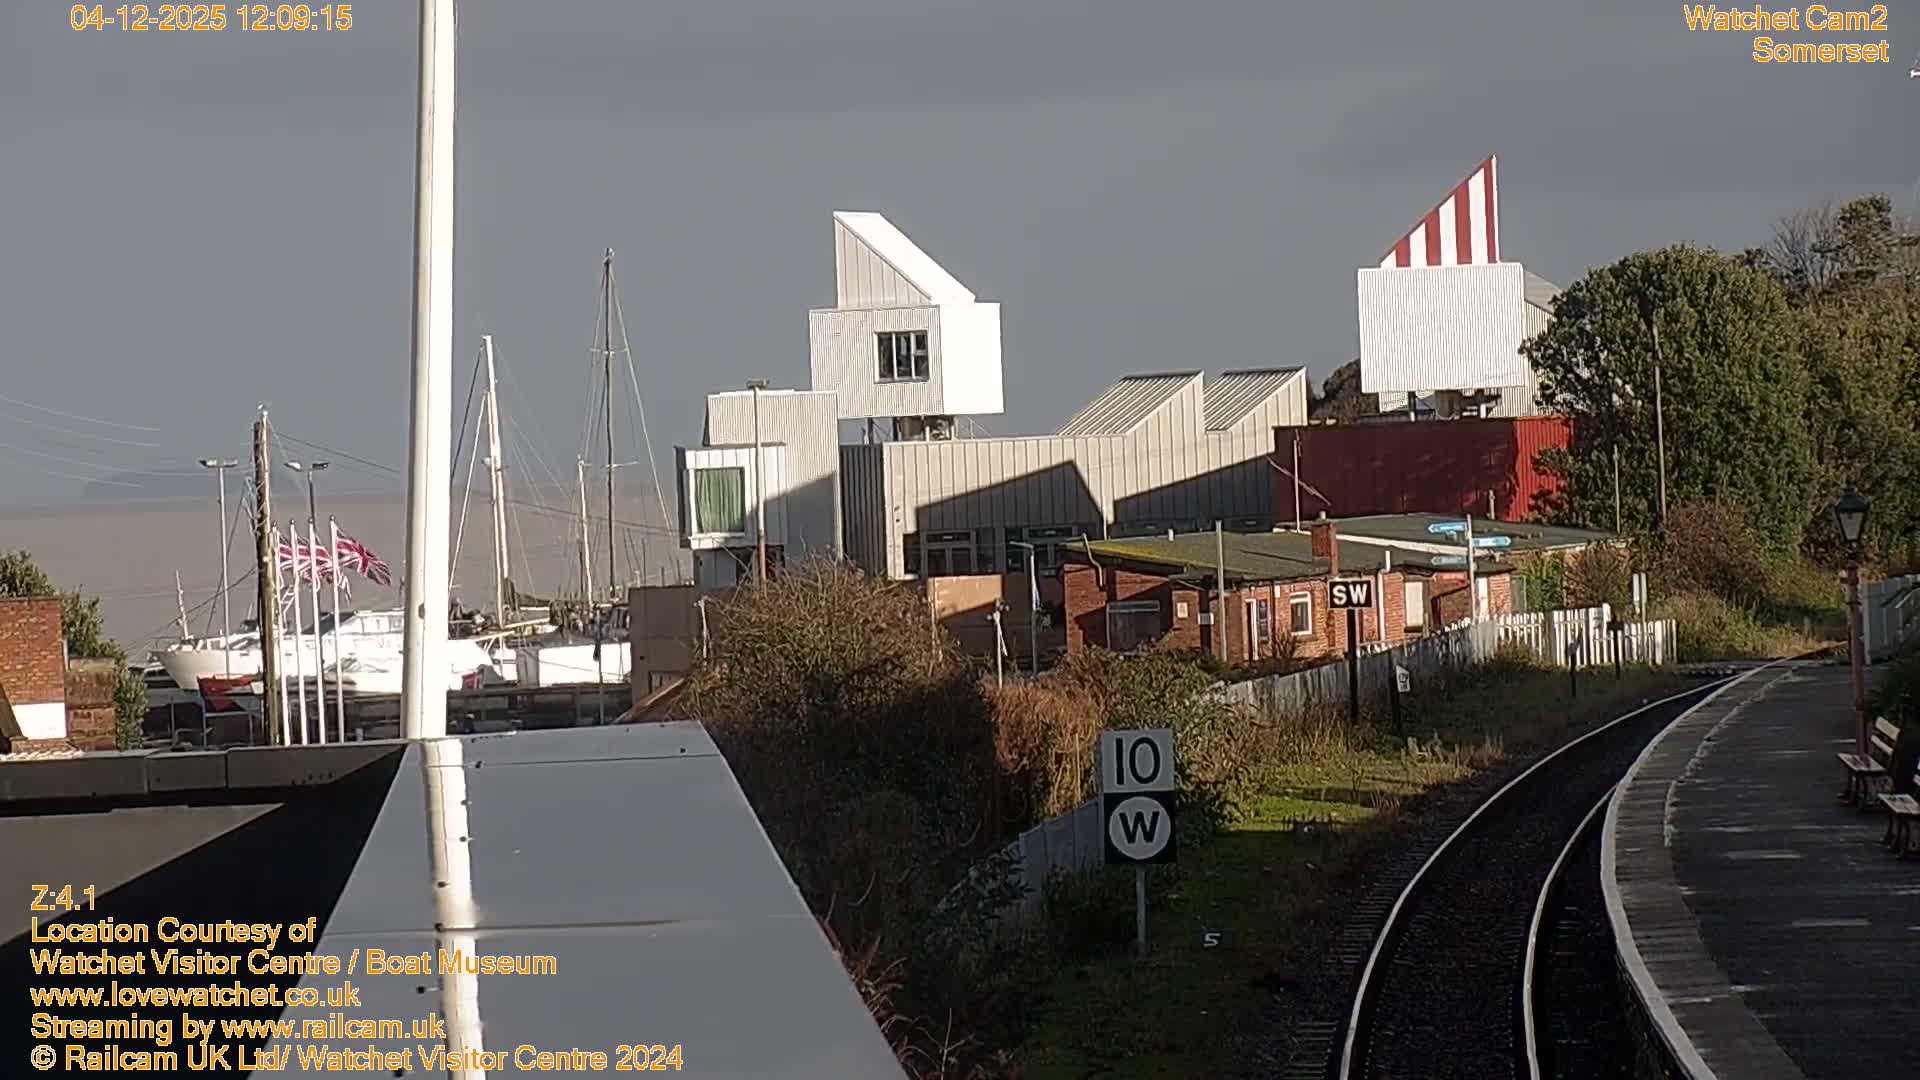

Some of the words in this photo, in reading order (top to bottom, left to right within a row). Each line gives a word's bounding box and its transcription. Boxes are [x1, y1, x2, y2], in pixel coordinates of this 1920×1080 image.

[1333, 588, 1367, 605] SW
[1115, 737, 1161, 785] 10
[1119, 811, 1160, 844] W
